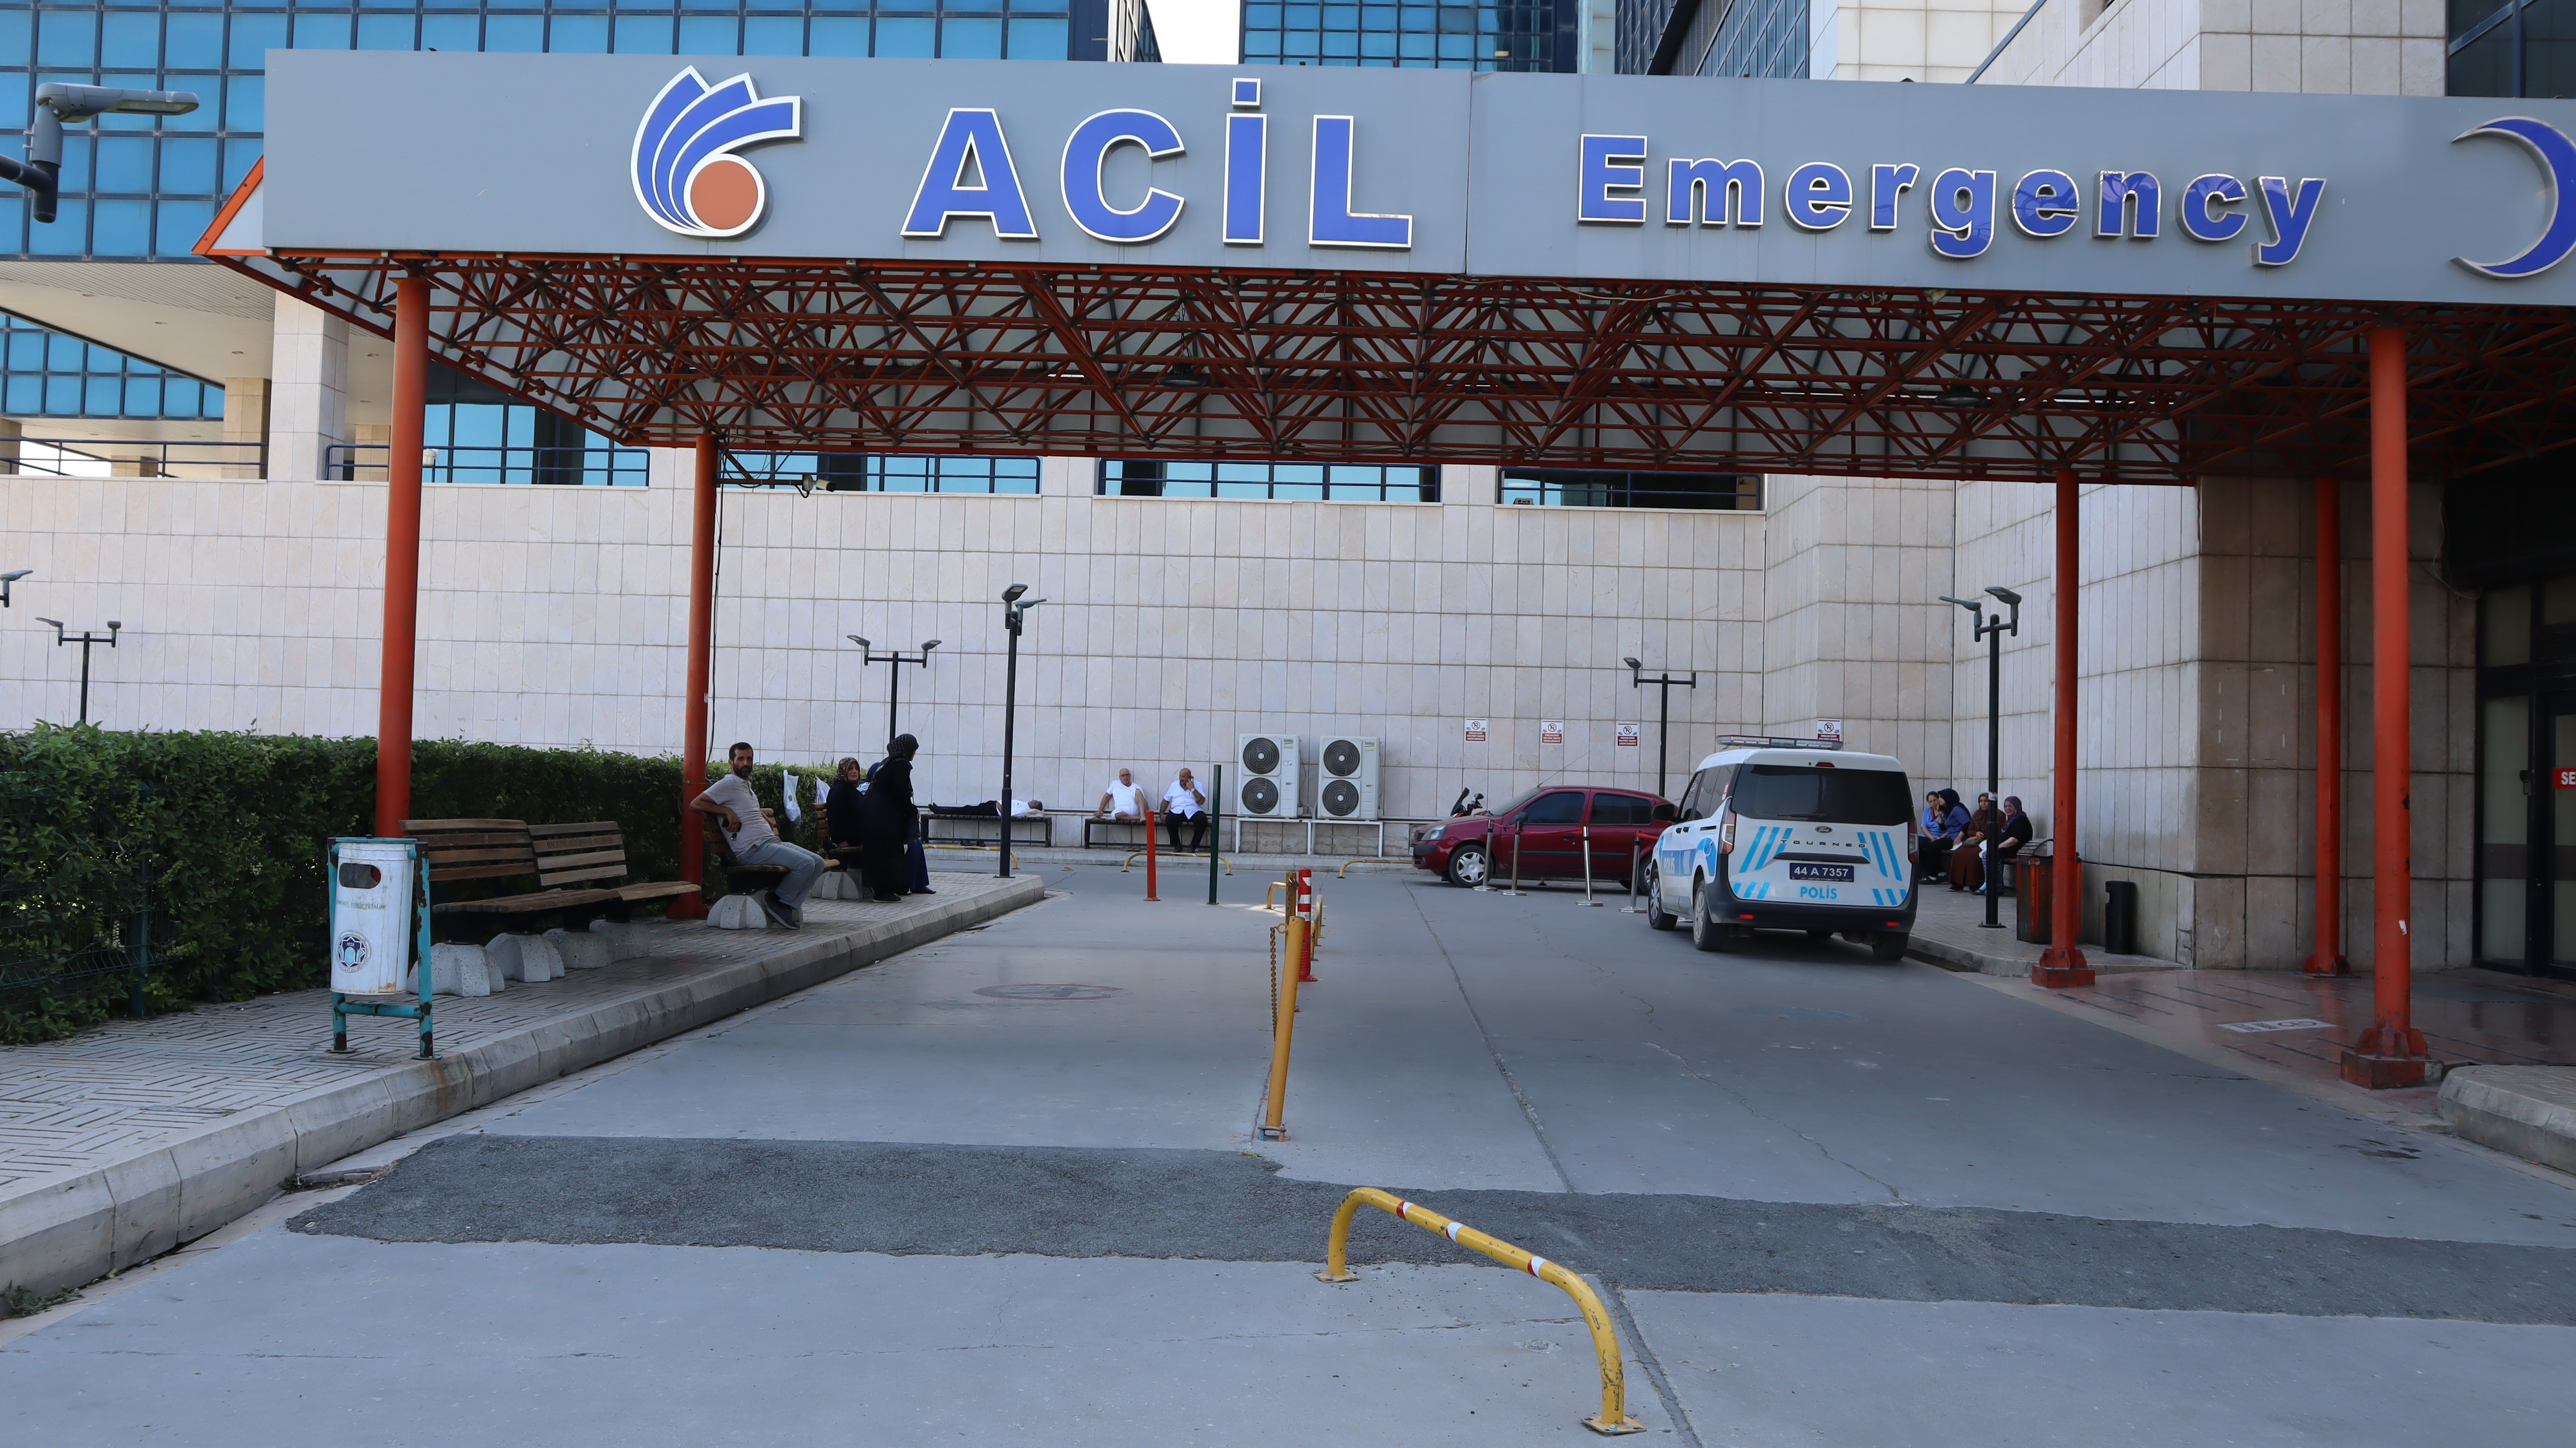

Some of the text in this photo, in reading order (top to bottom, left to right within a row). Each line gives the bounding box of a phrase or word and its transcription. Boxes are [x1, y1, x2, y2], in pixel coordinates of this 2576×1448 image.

[899, 78, 1413, 249] ACİL
[1578, 134, 2327, 267] Emergency
[1781, 840, 1865, 848] TOURNEO
[1664, 852, 1675, 874] POLİS
[1794, 866, 1849, 877] 44 A 7357
[1800, 885, 1838, 900] POLİS
